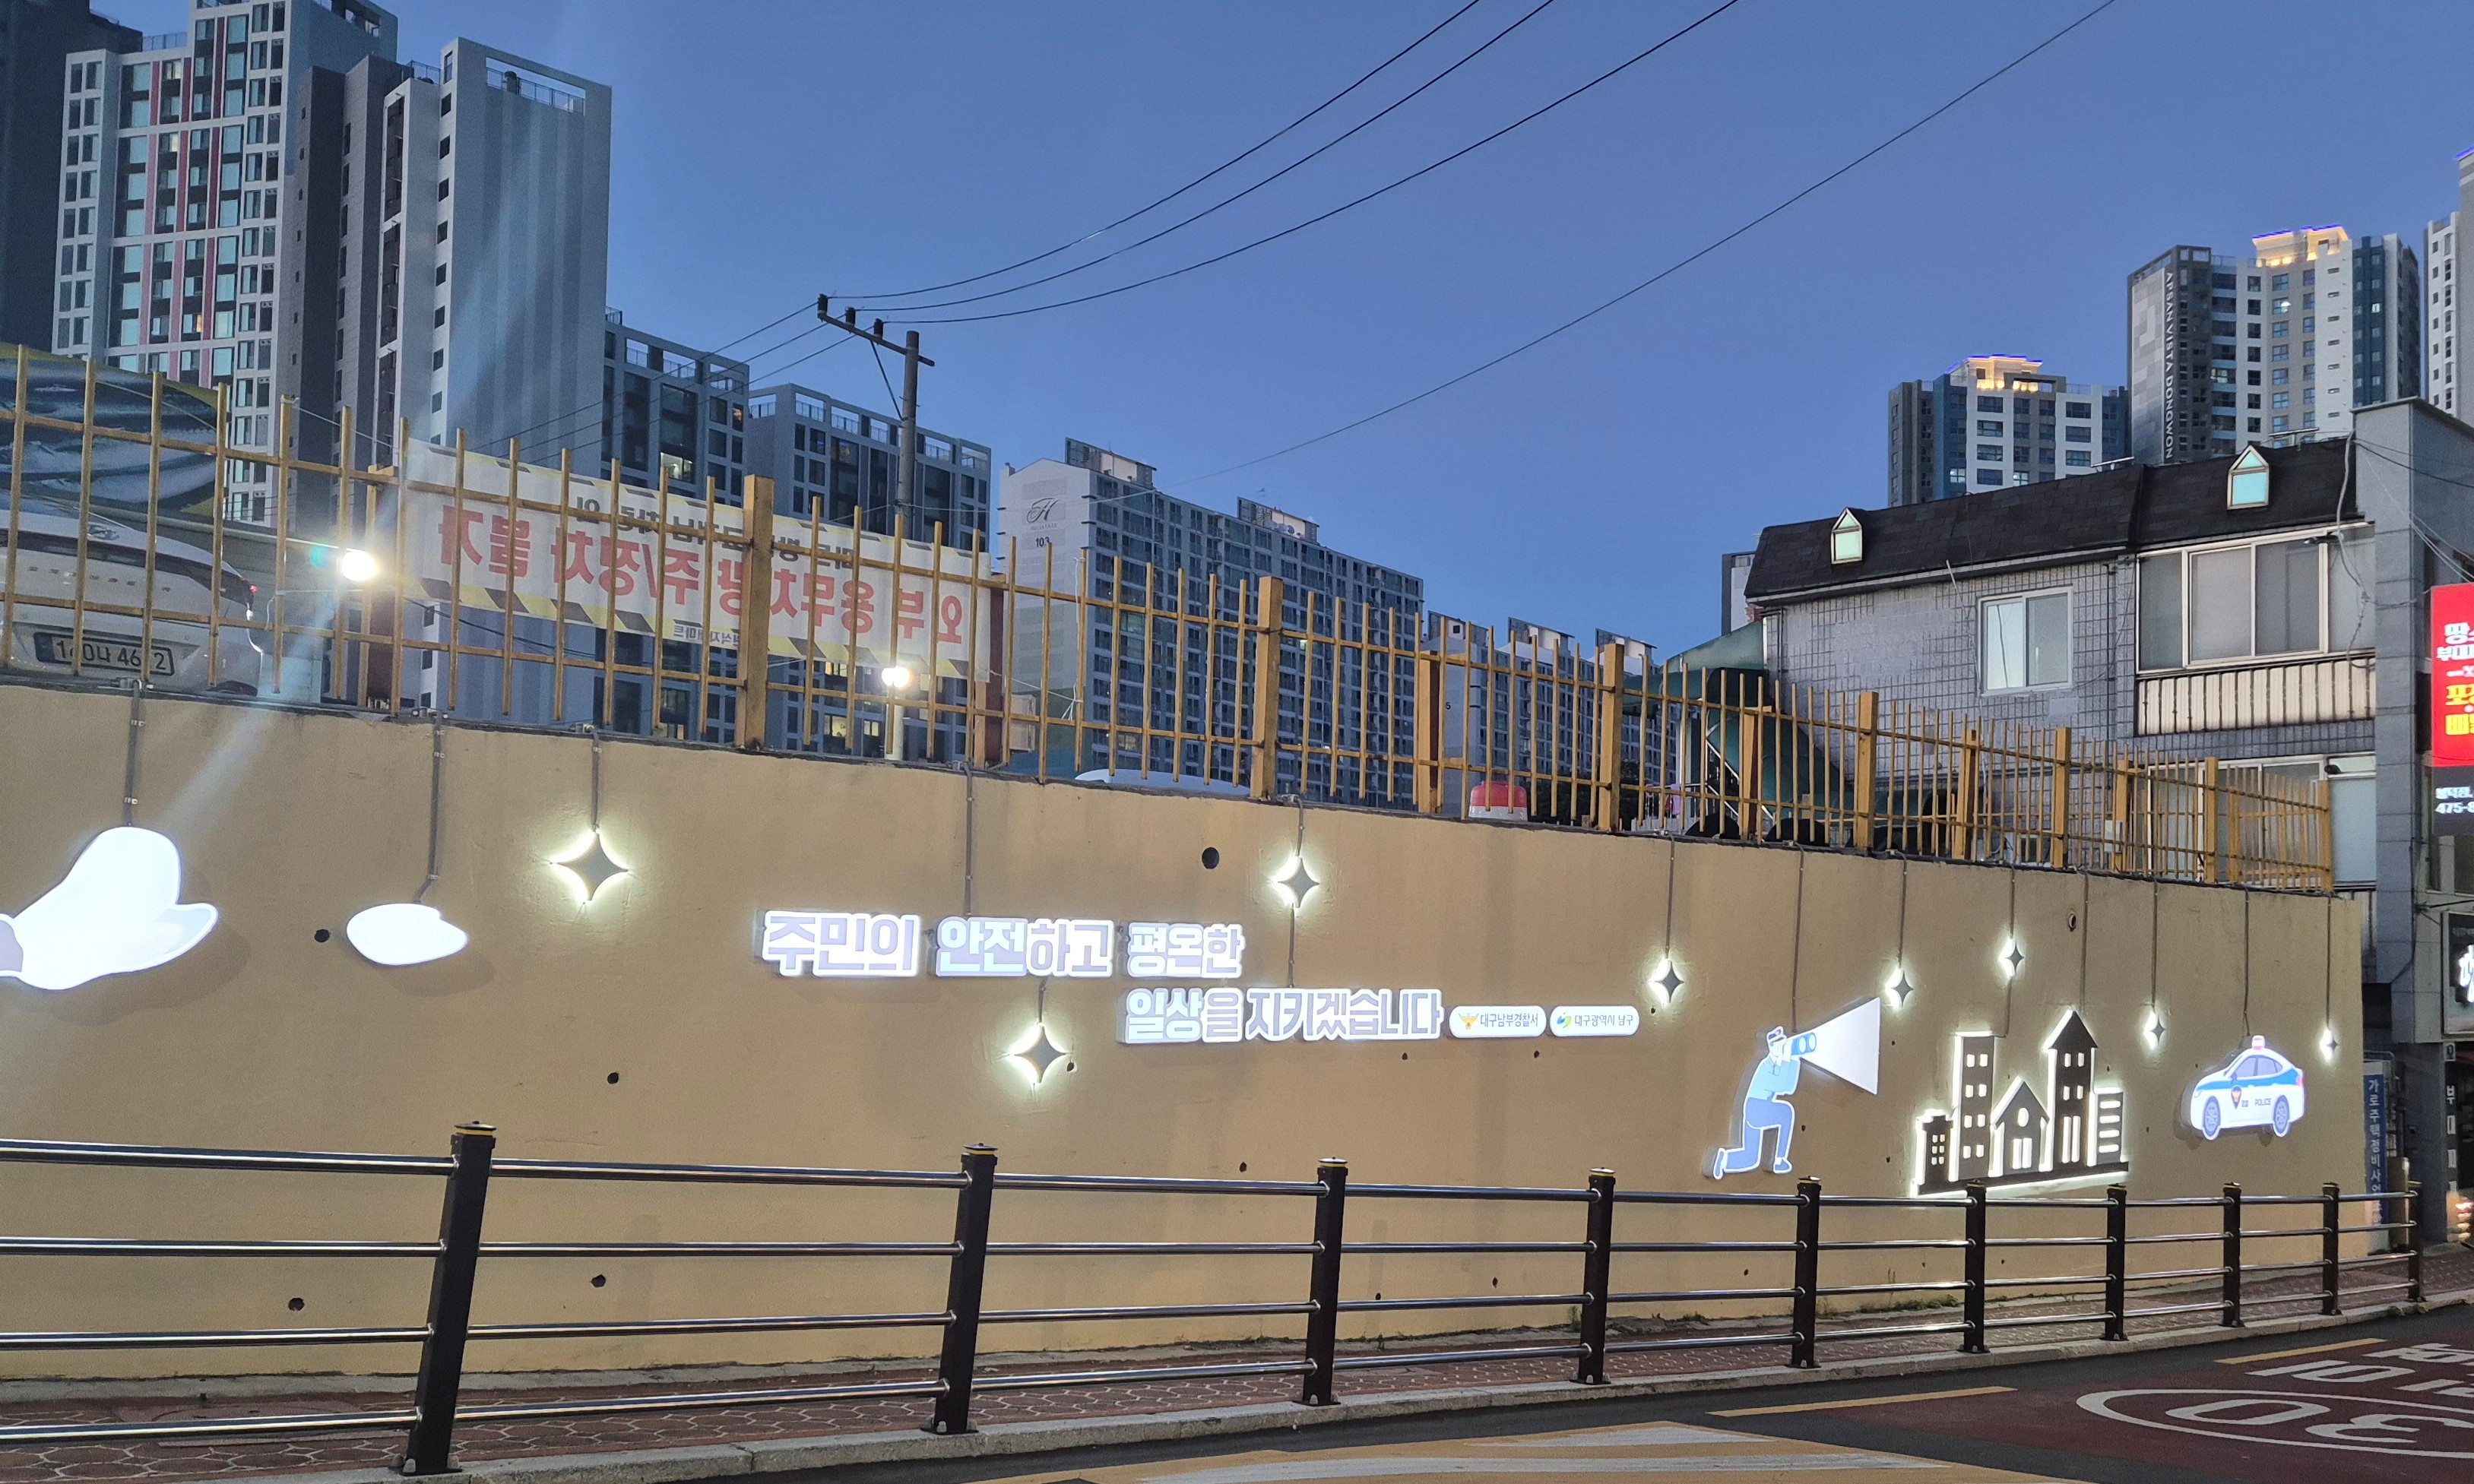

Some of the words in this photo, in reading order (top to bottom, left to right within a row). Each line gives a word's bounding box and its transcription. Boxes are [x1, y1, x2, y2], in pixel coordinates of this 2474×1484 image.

[2165, 324, 2174, 372] VISTA
[2165, 375, 2174, 459] DONGWON
[56, 640, 111, 663] 10나
[117, 647, 166, 670] 462
[764, 912, 918, 976] 주민의
[939, 918, 1113, 976] 안전하고
[1129, 922, 1243, 977] 평온한
[1128, 989, 1243, 1042] 일상을
[1246, 989, 1443, 1040] 지키겠습니다
[1480, 1012, 1538, 1027] 대구남부경찰서
[1574, 1014, 1615, 1027] 대구광역시
[1618, 1014, 1634, 1027] 남구
[2254, 1098, 2272, 1106] POLICE
